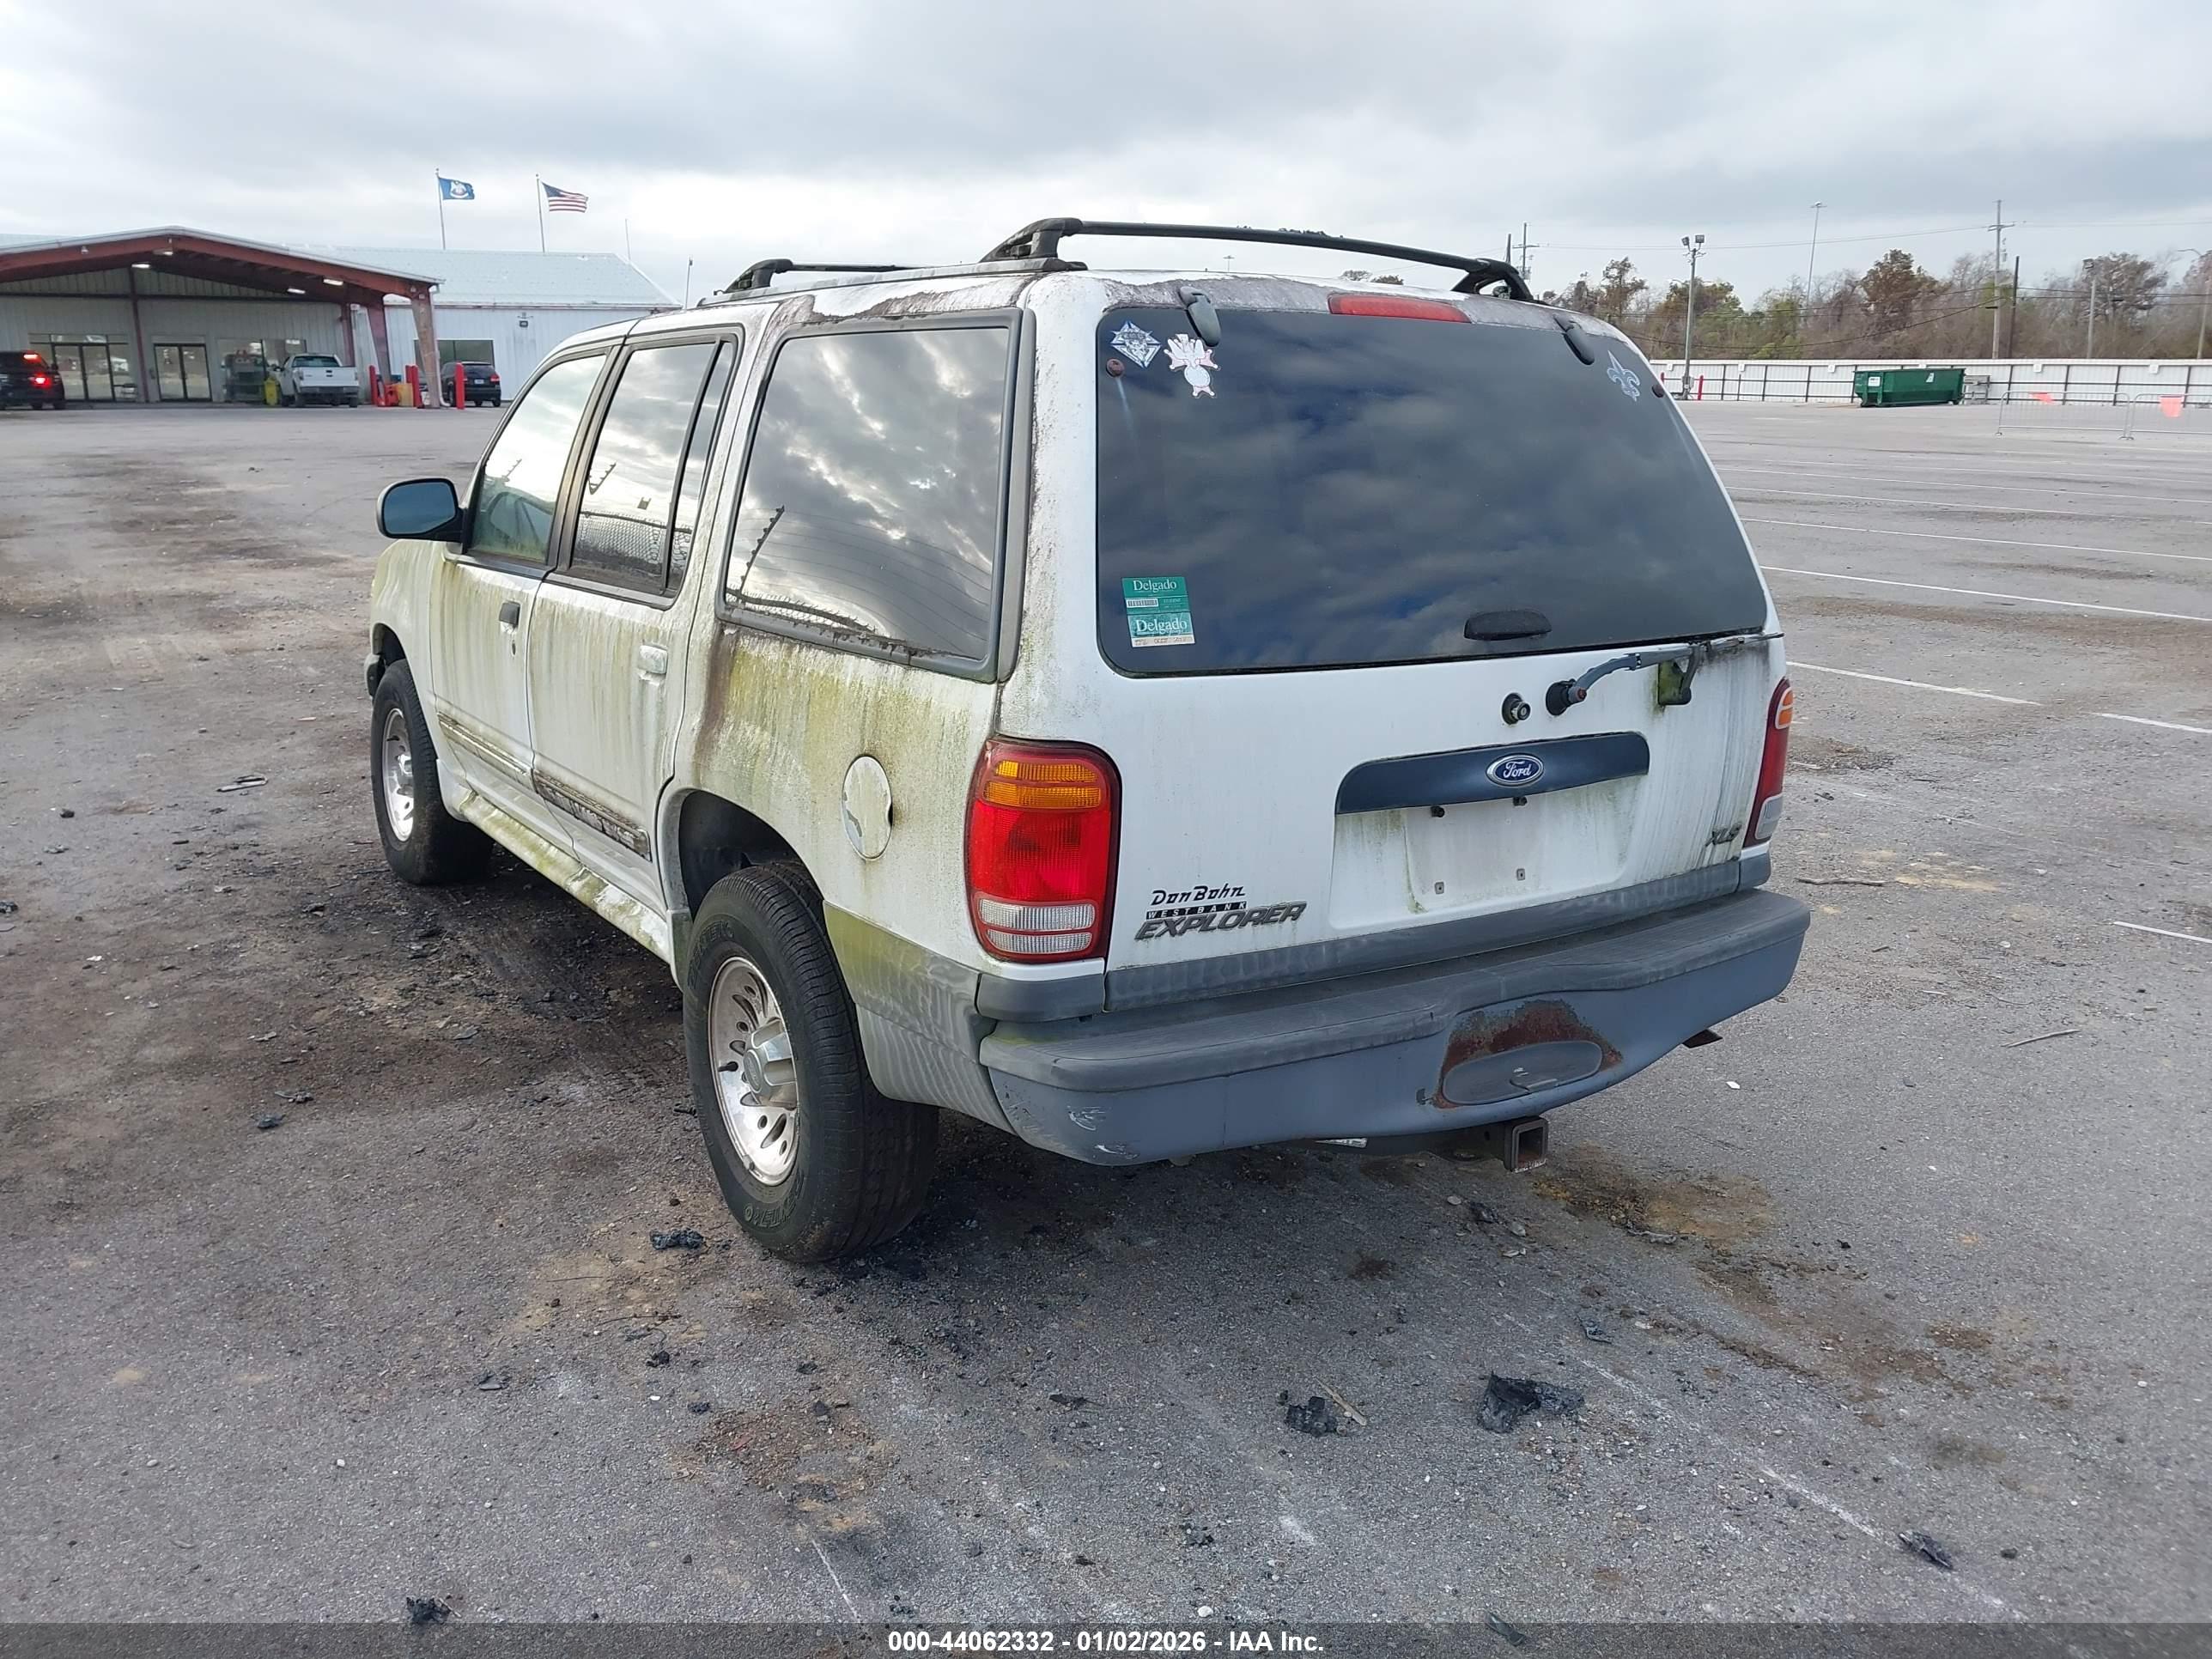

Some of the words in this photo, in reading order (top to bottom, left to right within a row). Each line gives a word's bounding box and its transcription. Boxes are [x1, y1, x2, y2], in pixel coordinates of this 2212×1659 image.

[1133, 579, 1177, 592] Delgado
[1135, 617, 1188, 634] Delgado
[1503, 761, 1532, 778] Ford
[1151, 890, 1192, 906] Don
[1193, 883, 1246, 902] Bohn
[1133, 901, 1307, 940] EXPLORER
